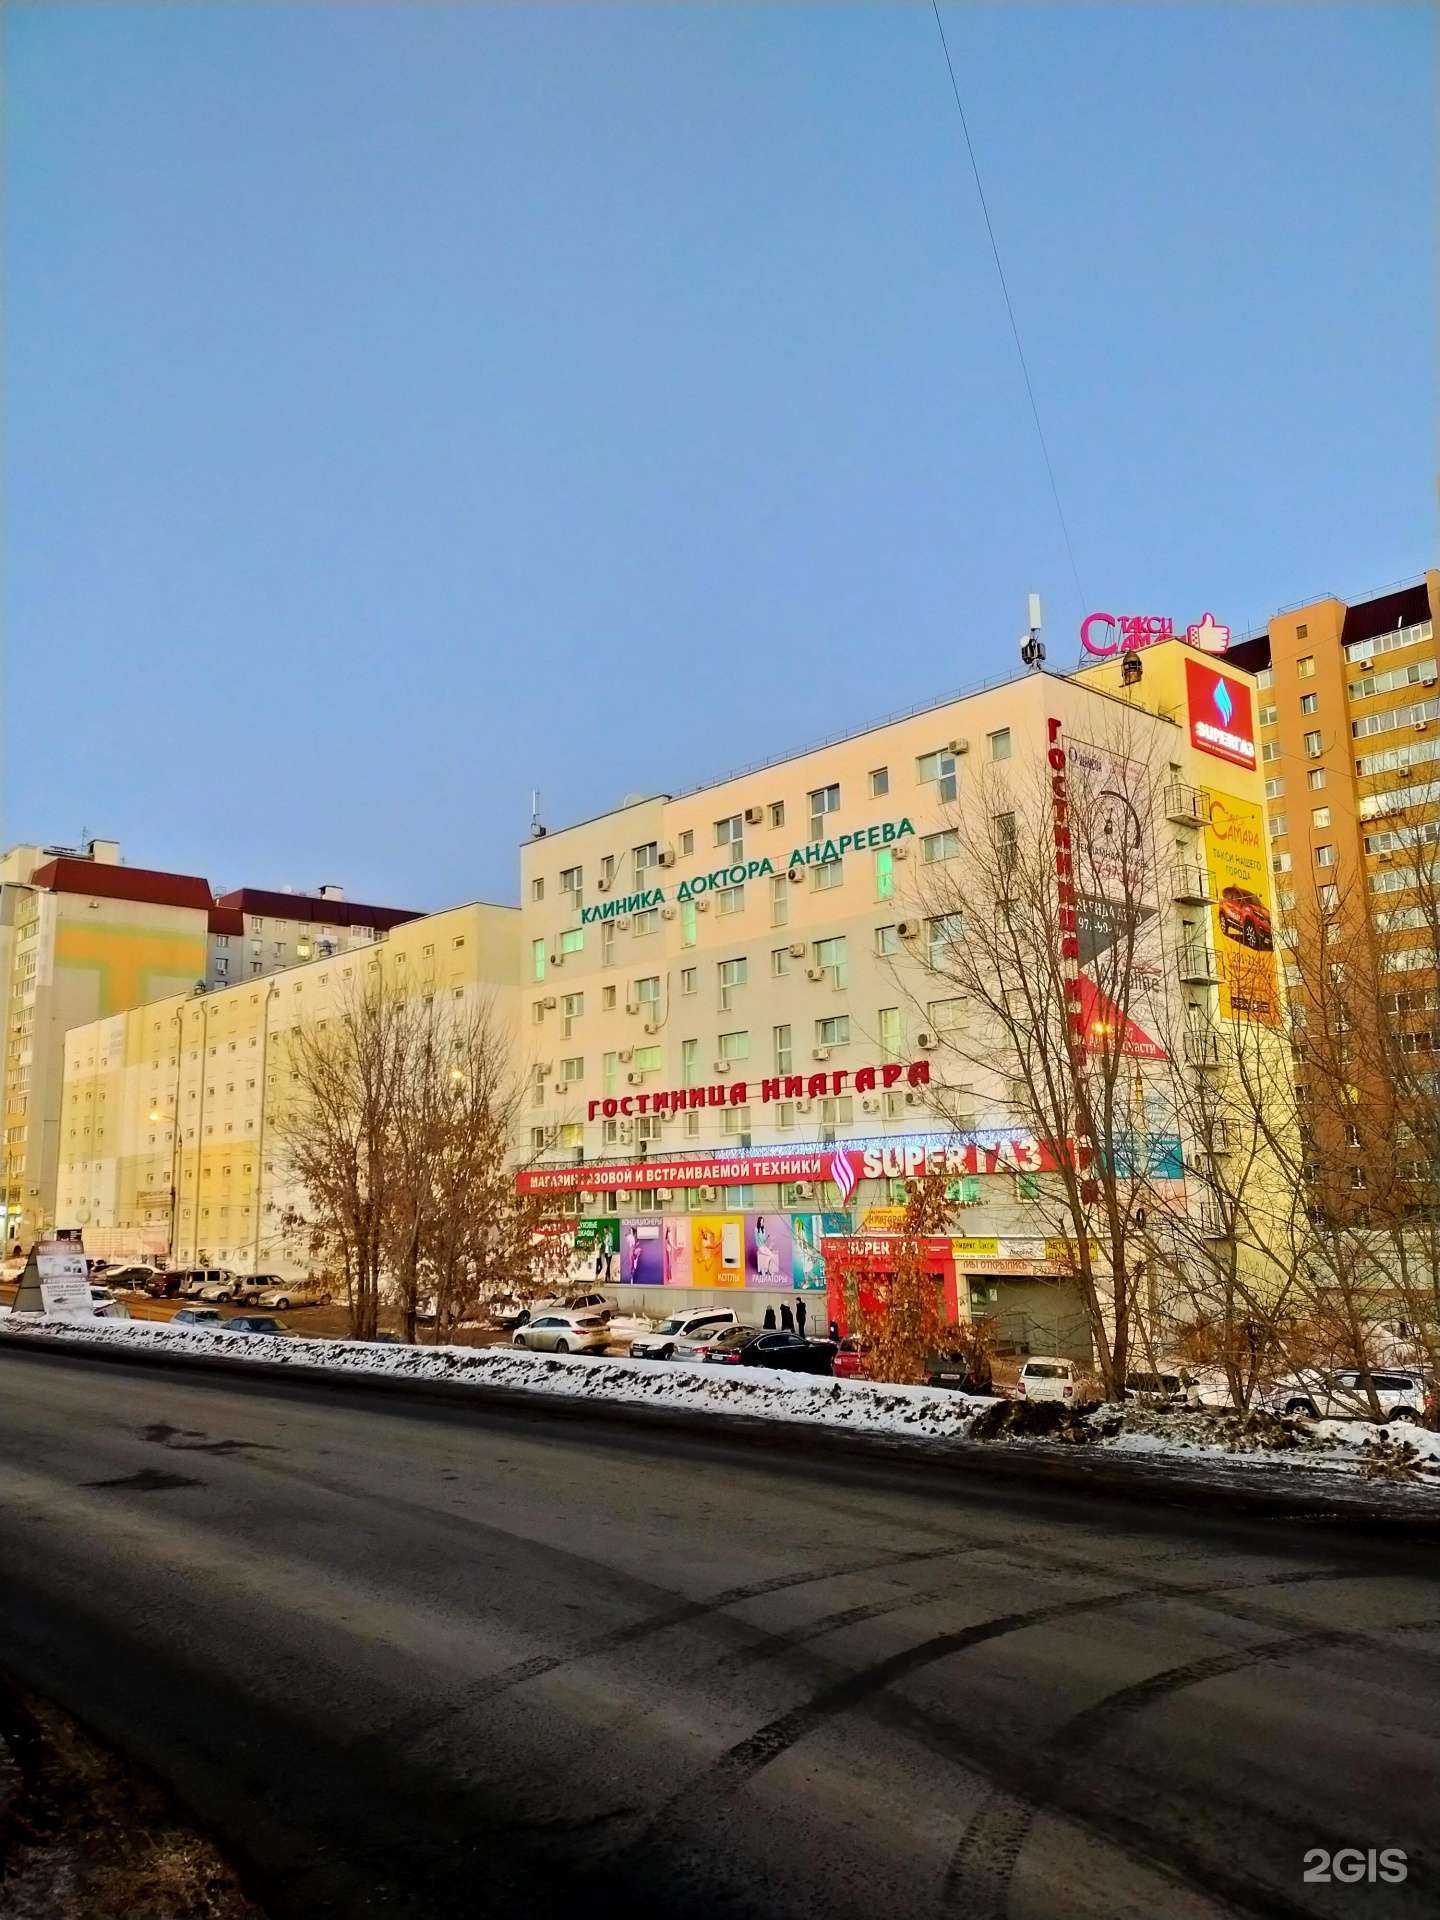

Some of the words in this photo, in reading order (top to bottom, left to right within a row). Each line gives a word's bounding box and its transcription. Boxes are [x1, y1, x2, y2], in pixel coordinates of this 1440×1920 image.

[1117, 615, 1173, 633] ТАКСИ
[580, 887, 666, 925] КЛИНИКА
[676, 857, 775, 902] ДОКТОРА
[789, 817, 916, 868] АНДРЕЕВА
[588, 1082, 747, 1121] ГОСТИНИЦА
[762, 1060, 930, 1103] НИАГАРА
[863, 1144, 969, 1178] SUPER
[976, 1137, 1042, 1174] ГАЗ
[635, 1170, 643, 1182] И
[646, 1162, 750, 1182] ВСТРАИВАЕМОЙ
[753, 1159, 821, 1176] ТЕХНИКИ
[848, 1241, 890, 1255] SUPER
[718, 1272, 740, 1283] КОТЛЫ
